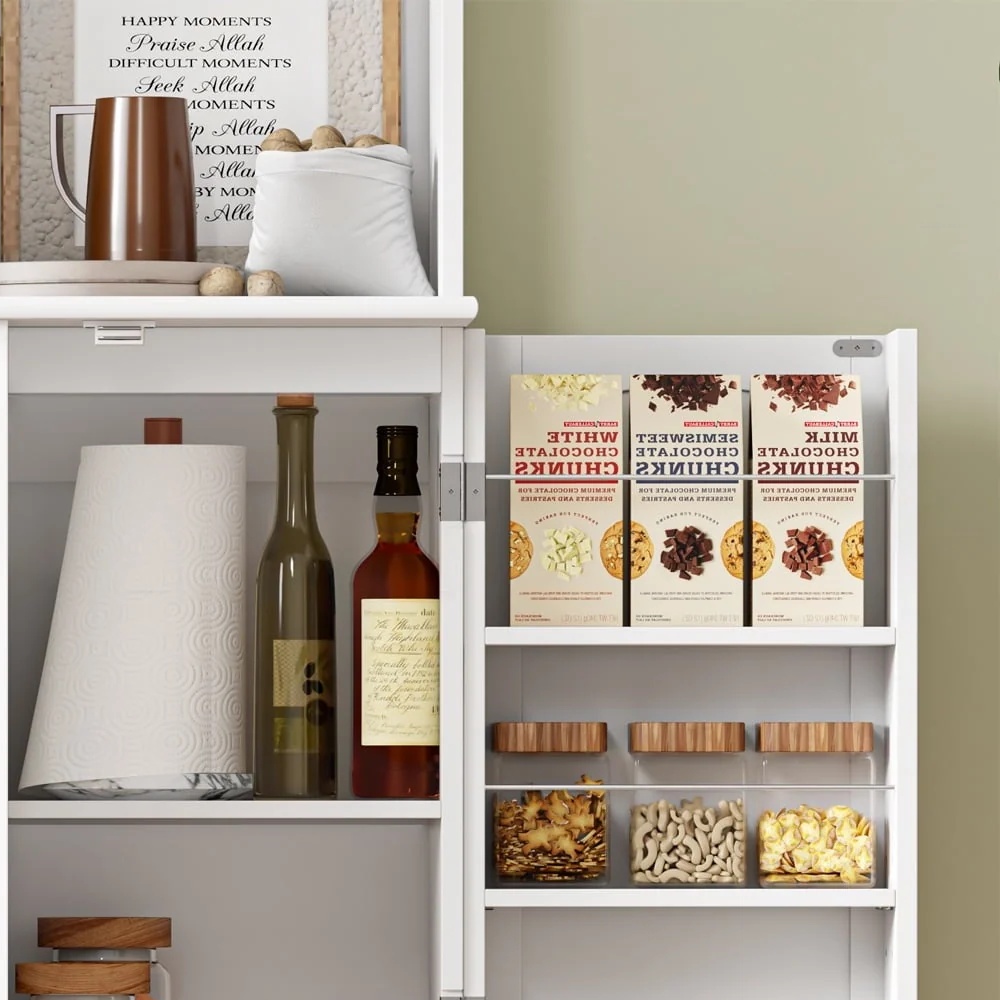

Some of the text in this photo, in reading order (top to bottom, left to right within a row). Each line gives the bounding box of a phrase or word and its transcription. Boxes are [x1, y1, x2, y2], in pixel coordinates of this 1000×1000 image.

[121, 16, 272, 27] HAPPY MOMENTS
[125, 33, 266, 52] Praise Allah
[108, 58, 292, 68] DIFFICULT MOMENTS
[135, 75, 257, 94] Seek Allah
[212, 118, 277, 137] Allah
[195, 145, 262, 155] MOMEN
